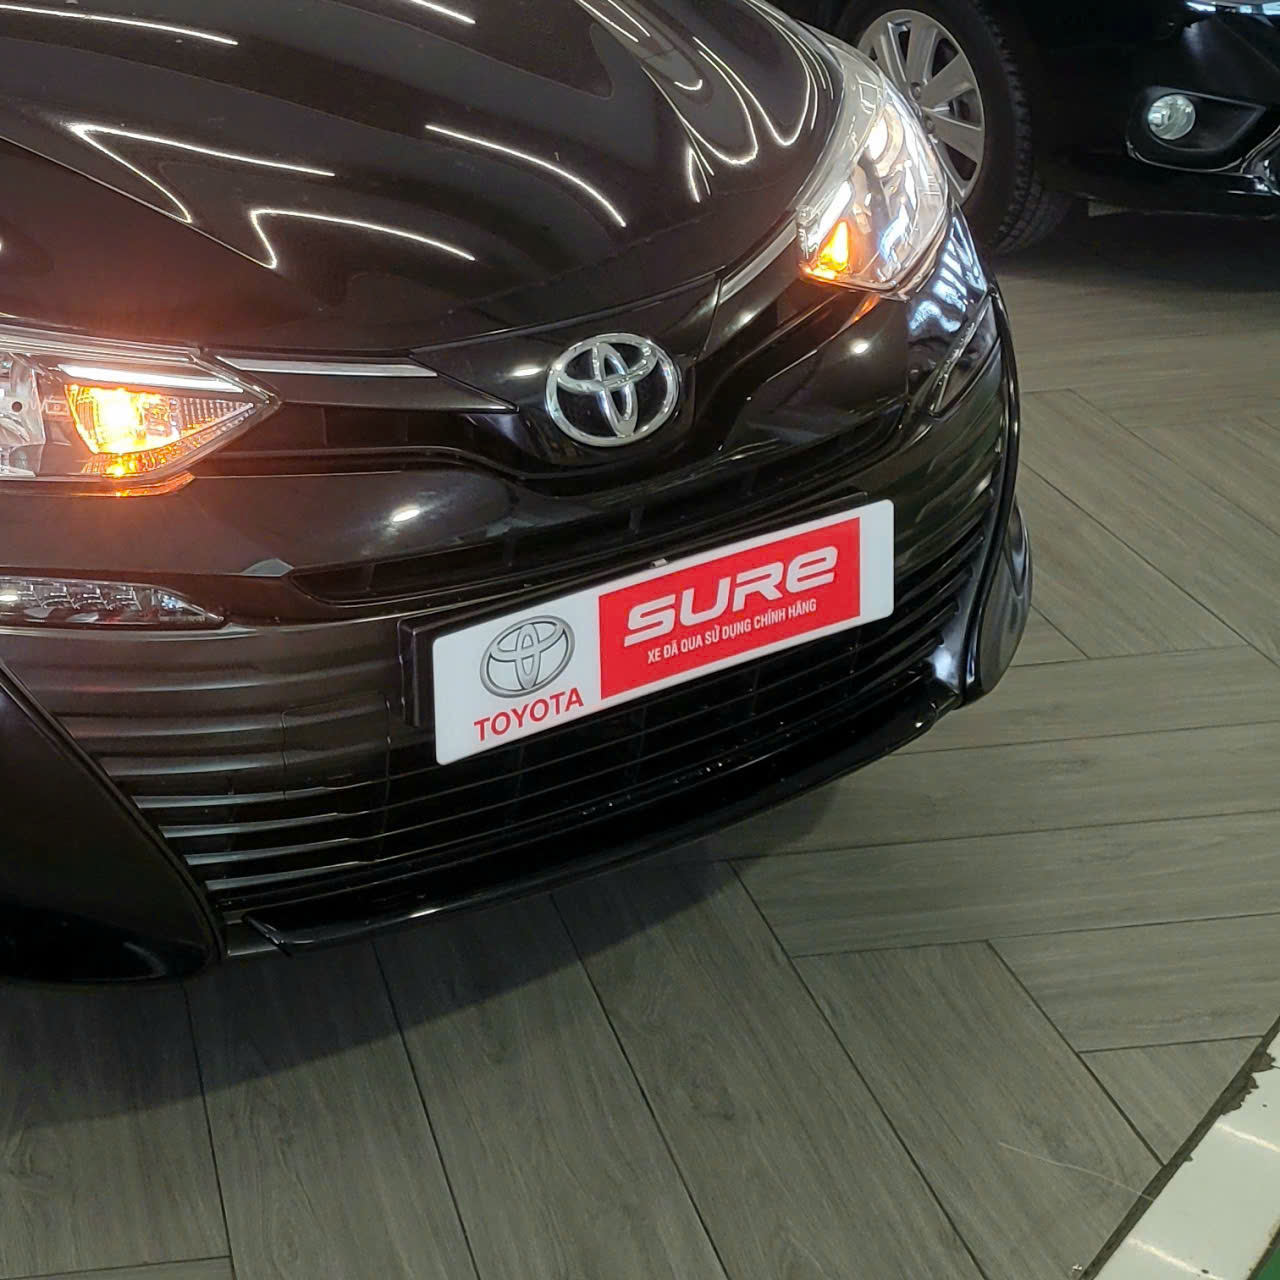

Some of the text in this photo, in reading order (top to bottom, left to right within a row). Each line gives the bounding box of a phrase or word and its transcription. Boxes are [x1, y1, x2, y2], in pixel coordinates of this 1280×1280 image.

[647, 649, 662, 664] XE
[681, 636, 704, 653] QUA
[722, 619, 752, 640] DỤNG
[753, 608, 787, 629] CHÍNH
[473, 687, 584, 742] TOYOTA
